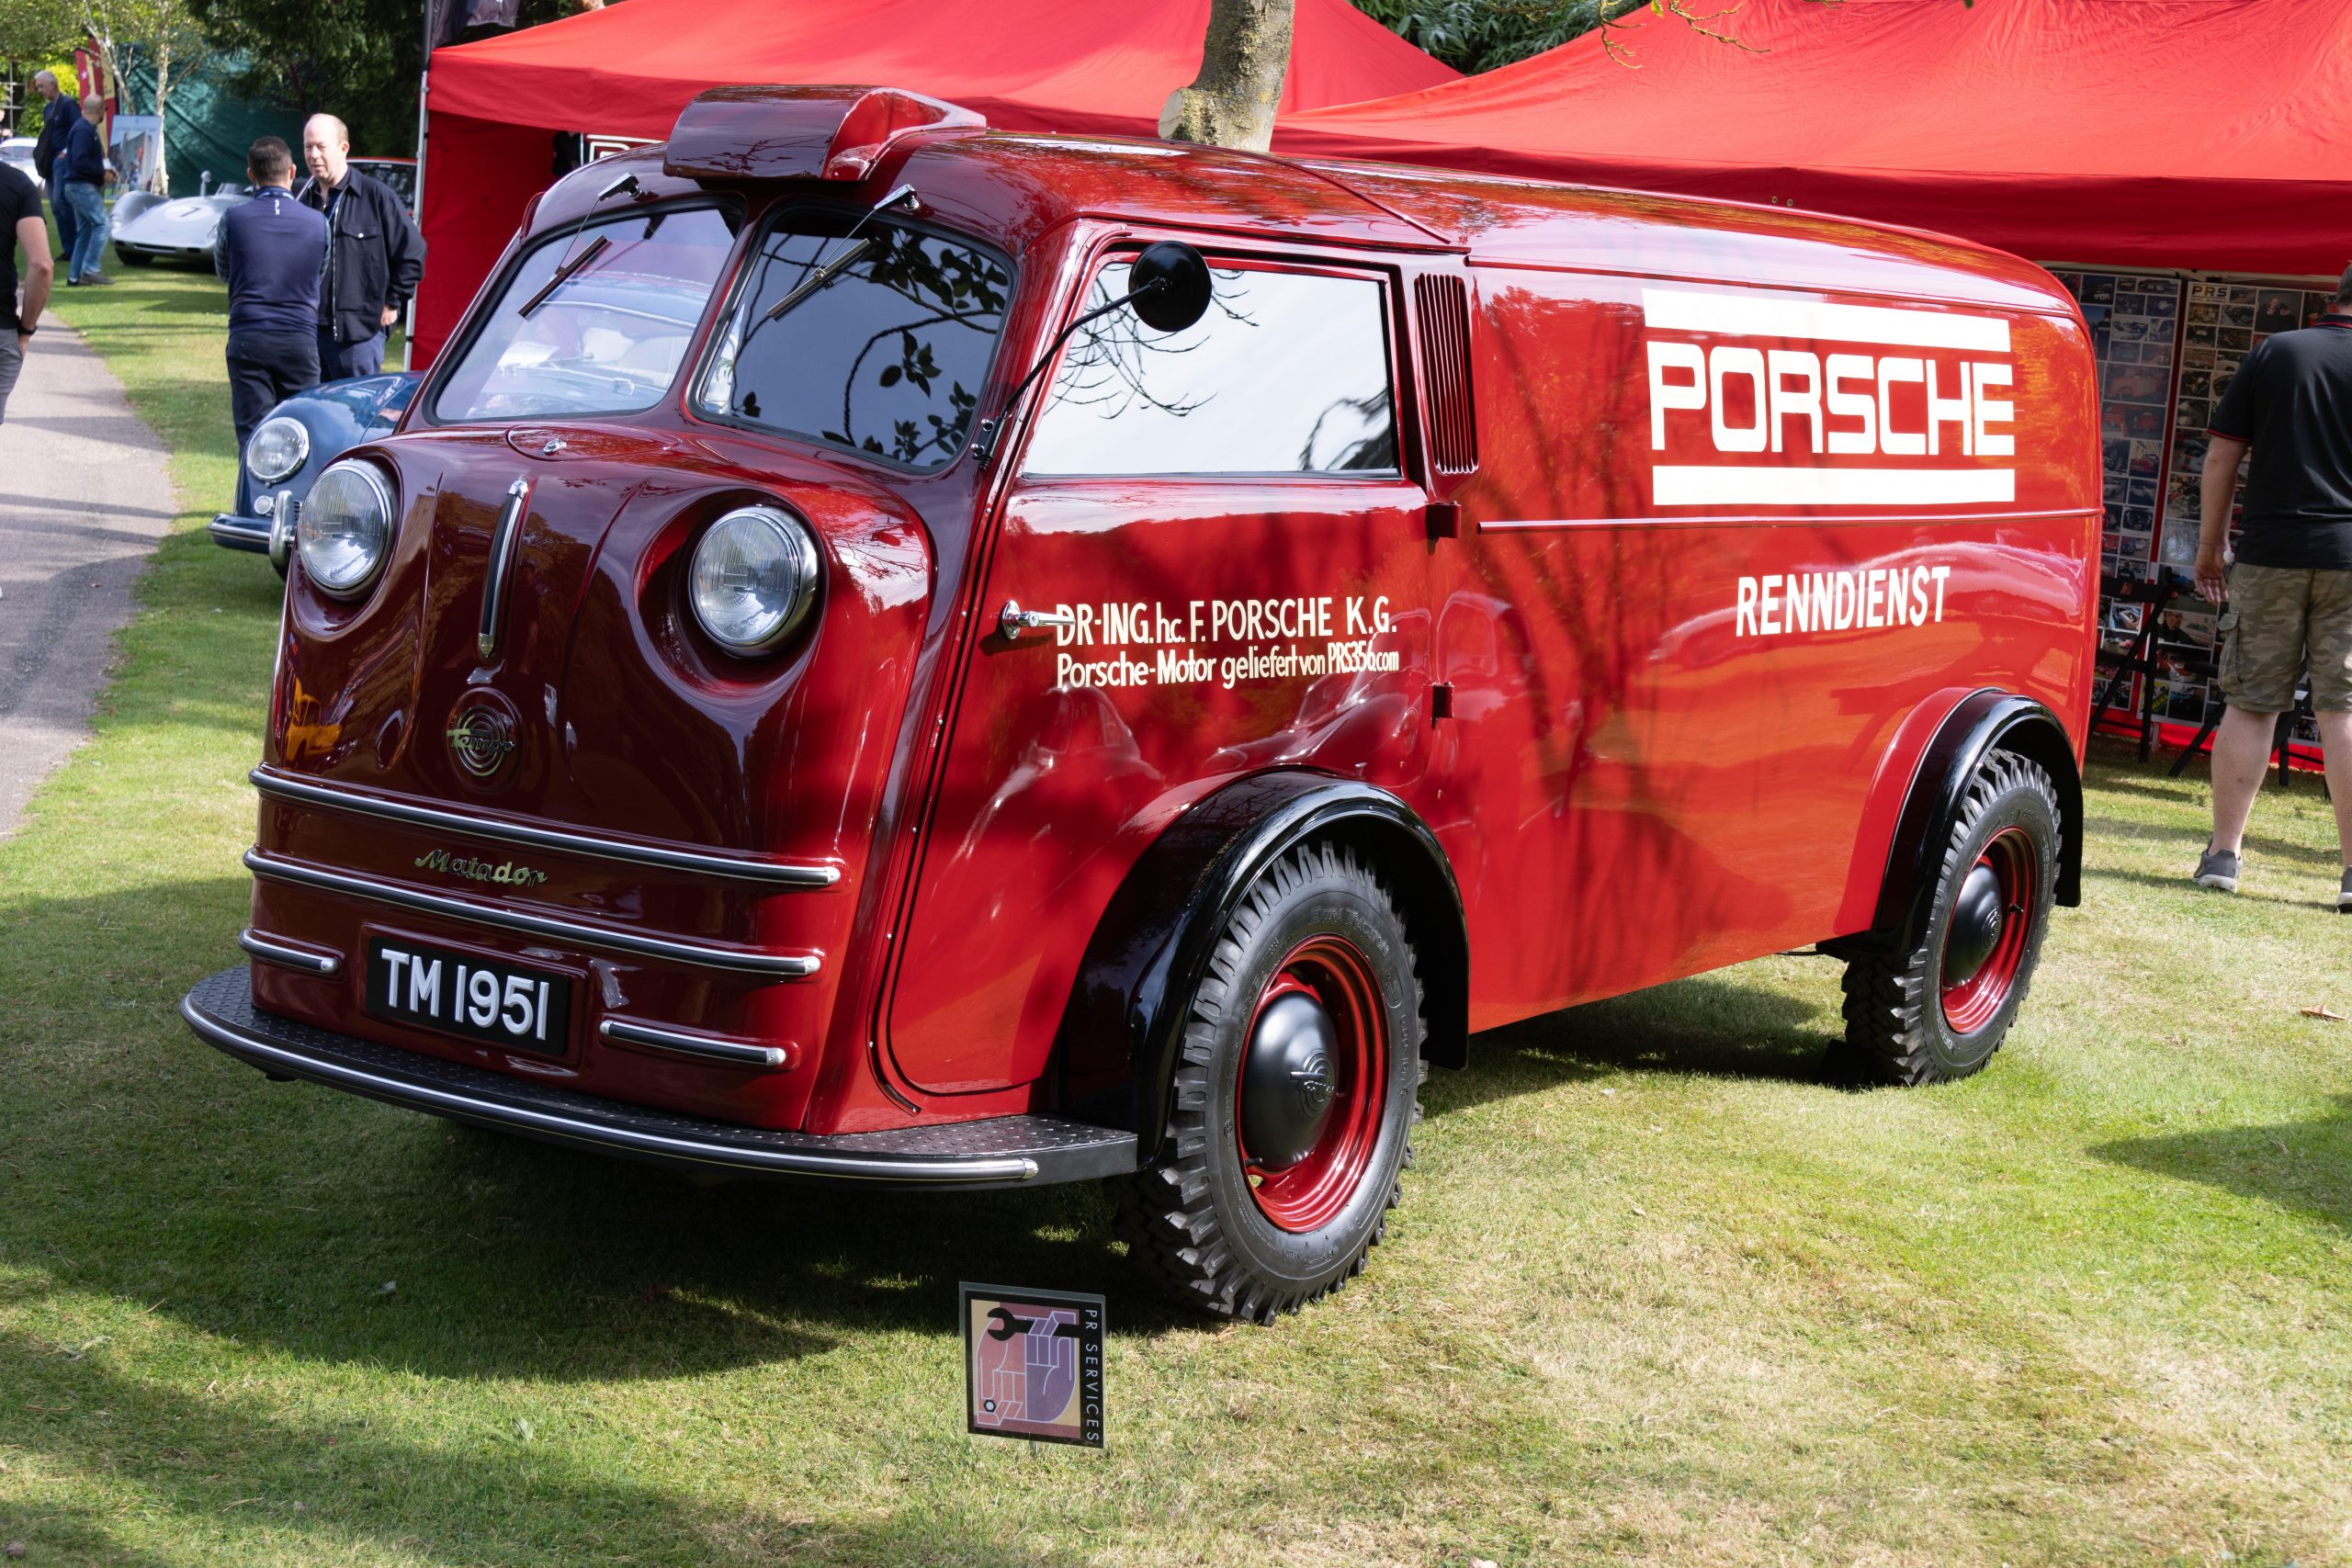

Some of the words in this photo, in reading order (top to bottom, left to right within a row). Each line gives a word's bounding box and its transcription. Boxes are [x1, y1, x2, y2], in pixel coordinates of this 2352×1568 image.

[2191, 286, 2228, 298] PRS
[1646, 341, 2015, 456] PORSCHE
[1056, 603, 1154, 647] DR-ING.
[1190, 600, 1206, 642] F.
[1212, 597, 1333, 641] PORSCHE
[1346, 595, 1397, 636] K.G.
[1736, 565, 1951, 637] RENNDIENST
[1057, 649, 1216, 689] Porsche-Motor
[1221, 645, 1297, 690] geliefert
[1298, 654, 1326, 676] von
[1327, 640, 1399, 674] PRS356.com
[446, 728, 515, 754] Tempo
[414, 849, 548, 887] Matador
[381, 948, 442, 1017] TM
[454, 964, 550, 1041] 1951
[1085, 1309, 1098, 1330] PR
[1085, 1343, 1100, 1440] SERVICES
